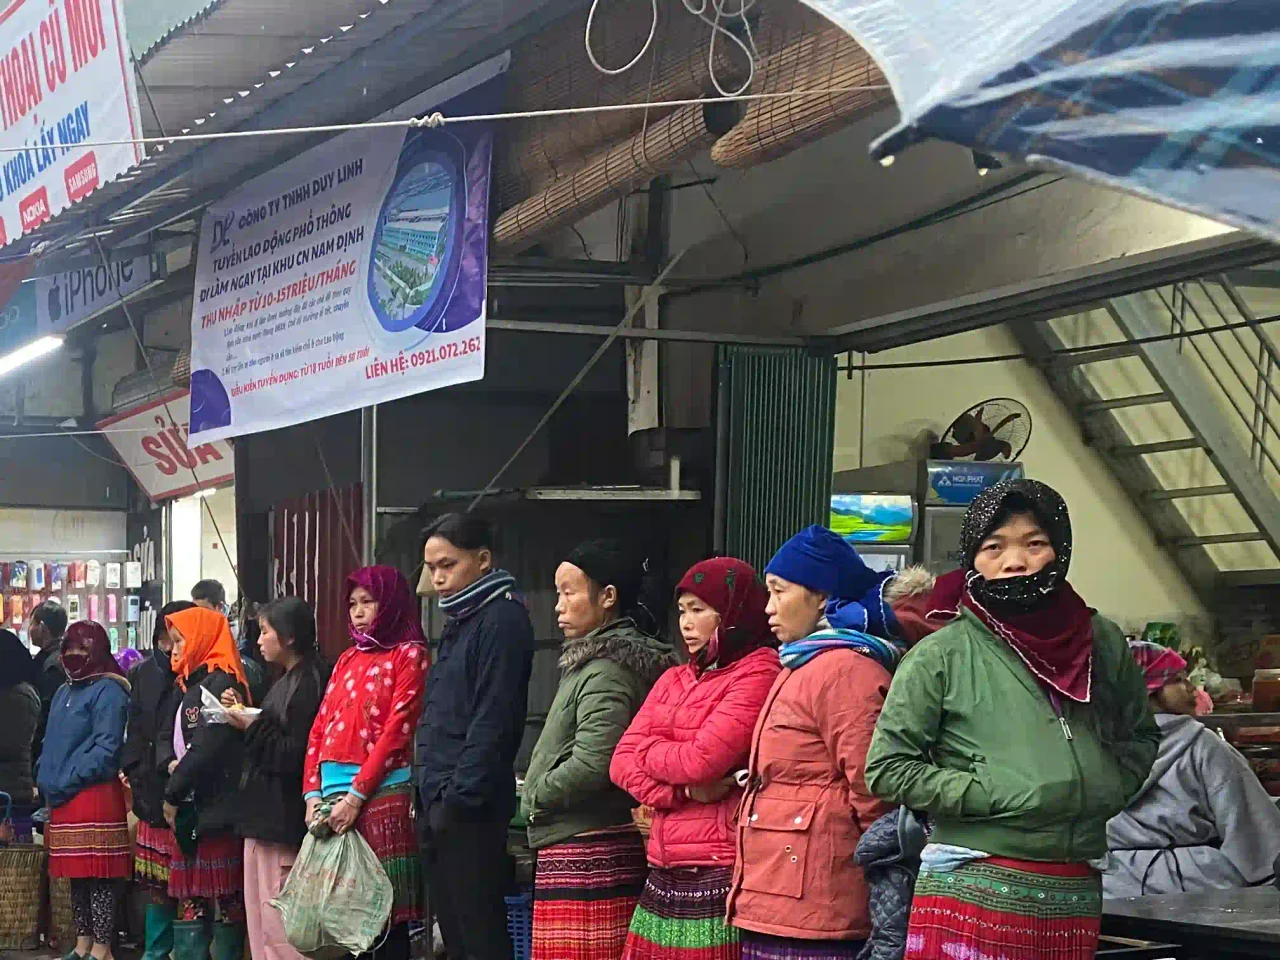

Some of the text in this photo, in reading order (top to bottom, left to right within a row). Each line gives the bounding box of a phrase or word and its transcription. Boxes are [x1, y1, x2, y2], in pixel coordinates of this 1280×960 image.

[57, 100, 91, 156] NGAY
[68, 162, 98, 194] SAMSUNG
[268, 198, 280, 217] TY
[282, 183, 310, 210] TNHH
[312, 172, 336, 195] DUY
[337, 158, 363, 184] LINH
[22, 198, 46, 225] NOKIA
[243, 244, 261, 261] LAO
[316, 203, 352, 231] THÔNG
[64, 258, 134, 316] iPhone
[208, 275, 230, 299] LÀM
[231, 269, 256, 292] NGAY
[257, 263, 271, 285] TẠI
[273, 253, 295, 277] KHU
[296, 250, 310, 266] CN
[311, 238, 334, 261] NAM
[336, 226, 365, 254] ĐỊNH
[201, 310, 219, 329] THU
[219, 296, 247, 323] NHẬP
[365, 357, 388, 379] LIÊN
[390, 350, 409, 375] HỆ:
[141, 415, 223, 476] SỬA
